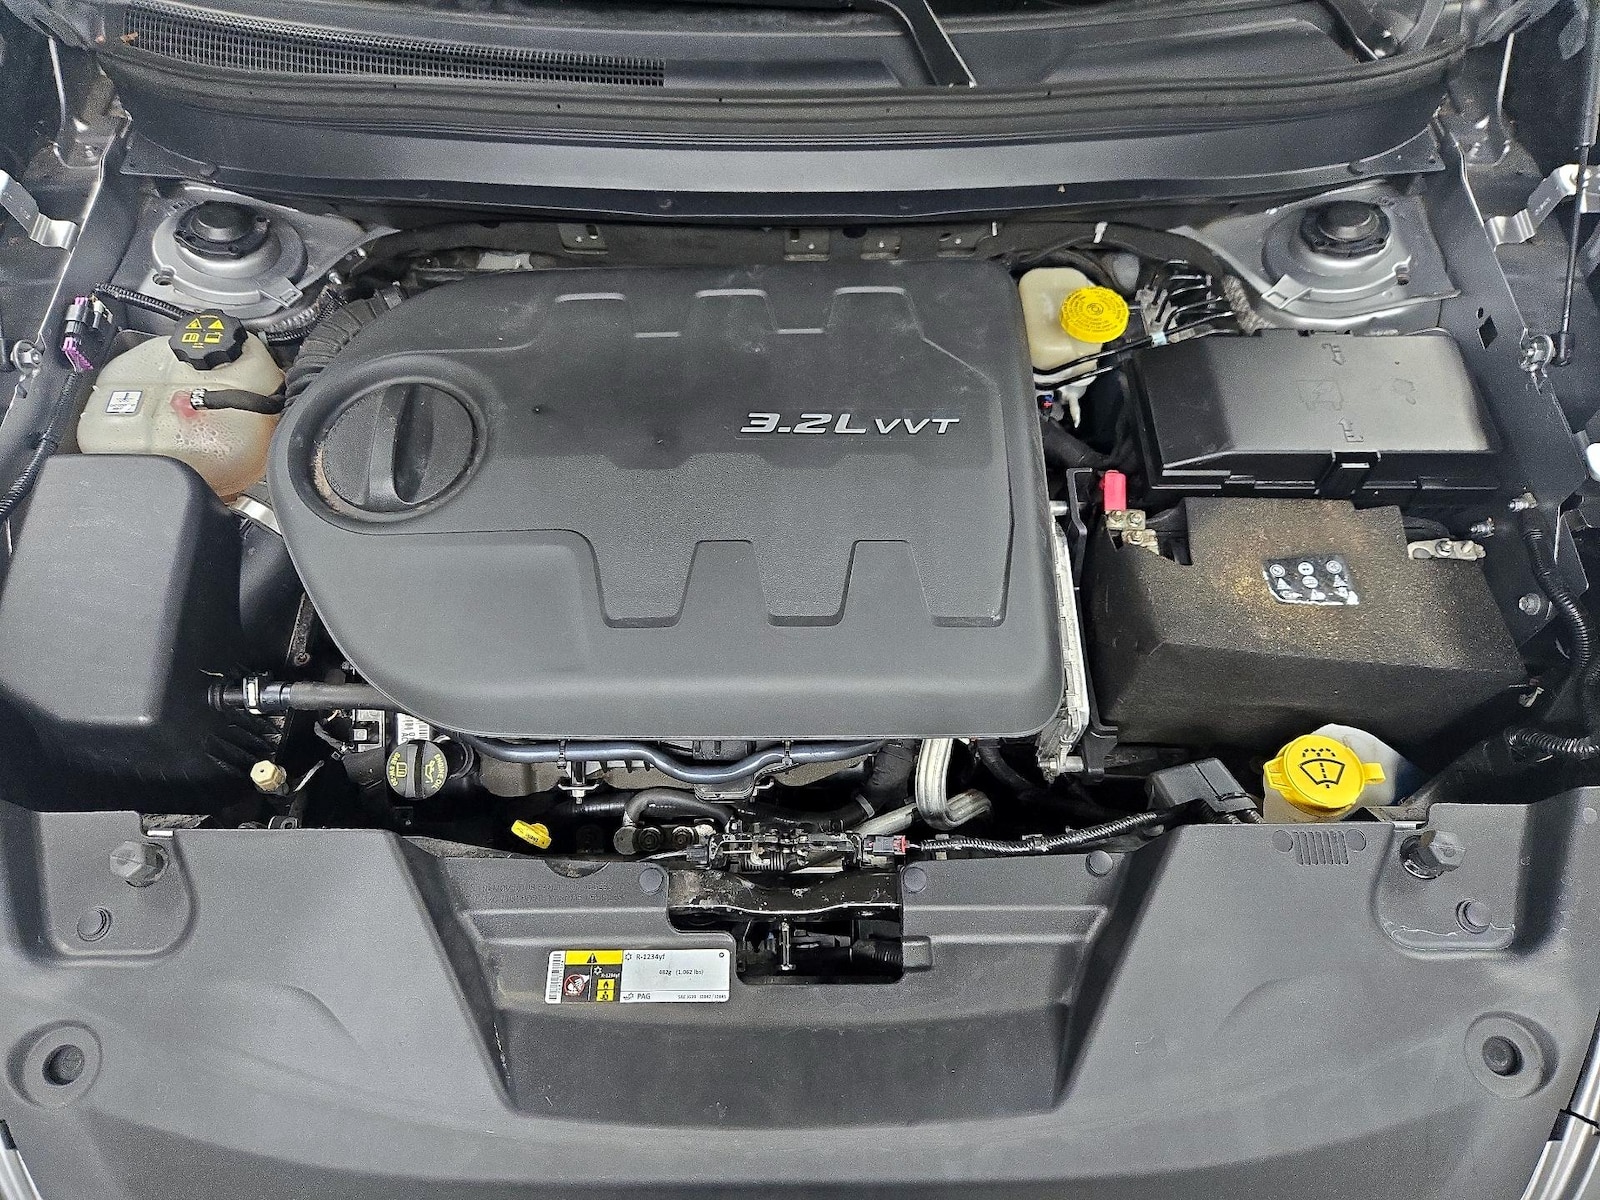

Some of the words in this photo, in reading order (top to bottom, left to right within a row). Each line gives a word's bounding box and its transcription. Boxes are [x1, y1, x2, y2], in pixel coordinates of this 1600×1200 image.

[740, 412, 867, 434] 3.2L
[875, 418, 960, 434] VVT
[390, 752, 400, 765] SAE
[434, 753, 445, 779] ENGINE
[431, 779, 443, 790] OIL
[636, 953, 666, 961] R-1234yf
[637, 992, 651, 1000] PAG
